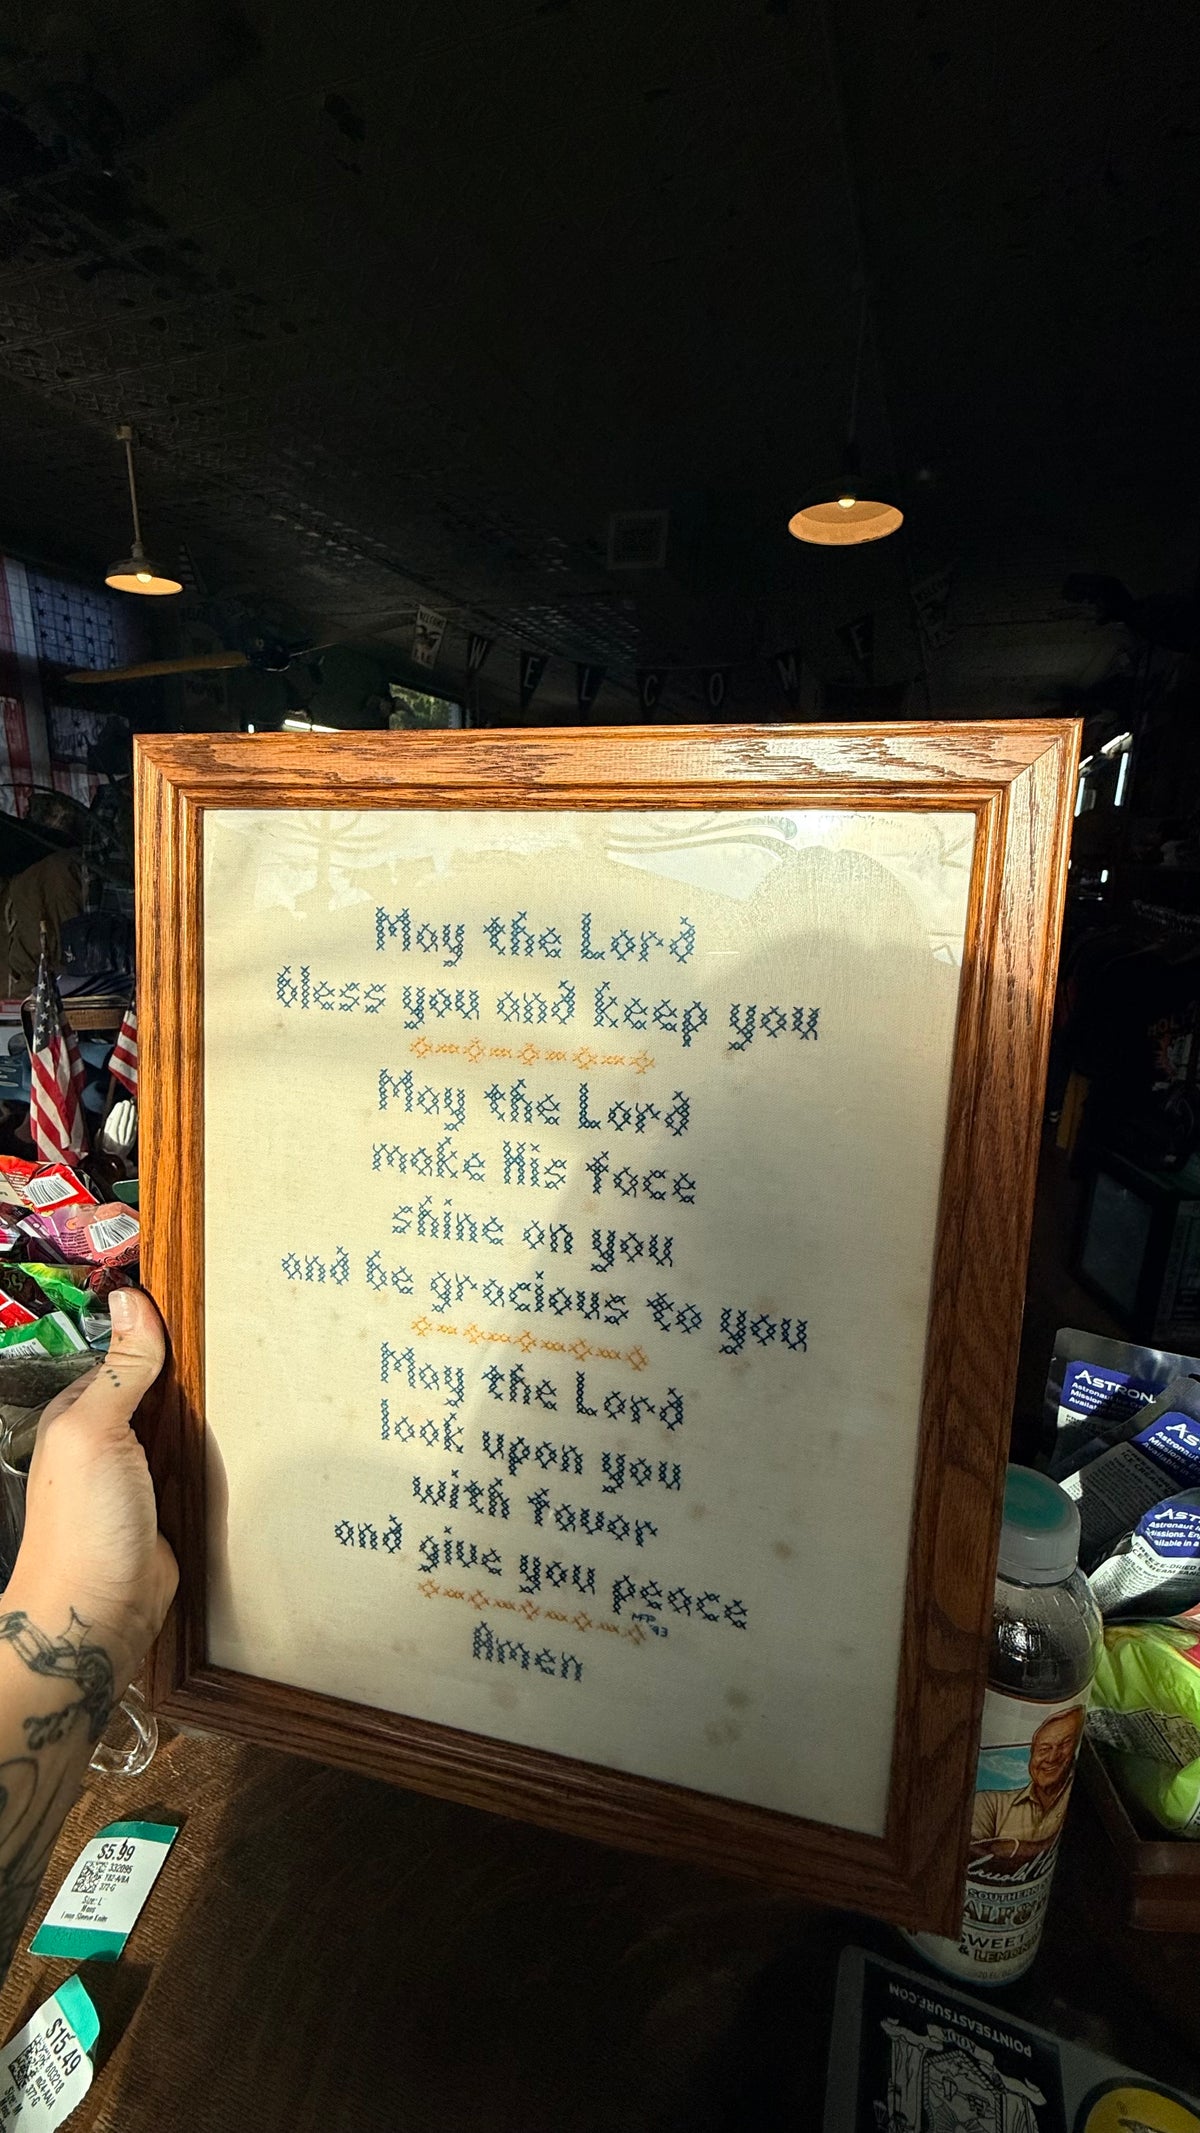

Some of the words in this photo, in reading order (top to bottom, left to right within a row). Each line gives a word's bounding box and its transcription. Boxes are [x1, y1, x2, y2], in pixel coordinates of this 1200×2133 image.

[376, 907, 465, 967] May
[483, 911, 562, 958] the
[580, 913, 696, 964] Lord
[277, 966, 386, 1014] bless
[402, 986, 479, 1030] you
[497, 980, 575, 1025] and
[593, 981, 708, 1047] keep
[729, 1003, 820, 1051] you
[378, 1069, 465, 1131] May
[484, 1079, 560, 1126] the
[578, 1082, 690, 1136] Lord
[372, 1136, 485, 1182] make
[503, 1140, 567, 1190] His
[585, 1151, 696, 1205] face
[392, 1196, 504, 1245] shine
[522, 1220, 574, 1254] on
[591, 1229, 673, 1272] you
[282, 1246, 350, 1286] and
[366, 1250, 413, 1295] be
[430, 1271, 629, 1326] gracious
[646, 1292, 702, 1334] to
[720, 1308, 808, 1355] you
[381, 1342, 465, 1407] May
[481, 1364, 557, 1411] the
[576, 1371, 684, 1431] Lord
[1074, 1369, 1157, 1404] ASTRON
[381, 1398, 465, 1454] look
[482, 1430, 583, 1476] upon
[601, 1452, 681, 1493] you
[1165, 1423, 1200, 1451] AS
[412, 1469, 510, 1520] with
[527, 1488, 658, 1548] favor
[1148, 1522, 1194, 1531] Astronaut
[1154, 1508, 1200, 1524] AST
[335, 1514, 402, 1554] and
[418, 1526, 502, 1576] give
[519, 1554, 595, 1595] you
[613, 1575, 748, 1630] peace
[473, 1621, 583, 1681] Amen
[97, 1843, 136, 1861] $5.99
[968, 1884, 1040, 1902] SOUTHERN
[959, 1945, 969, 1956] &
[45, 2017, 82, 2076] $15.49
